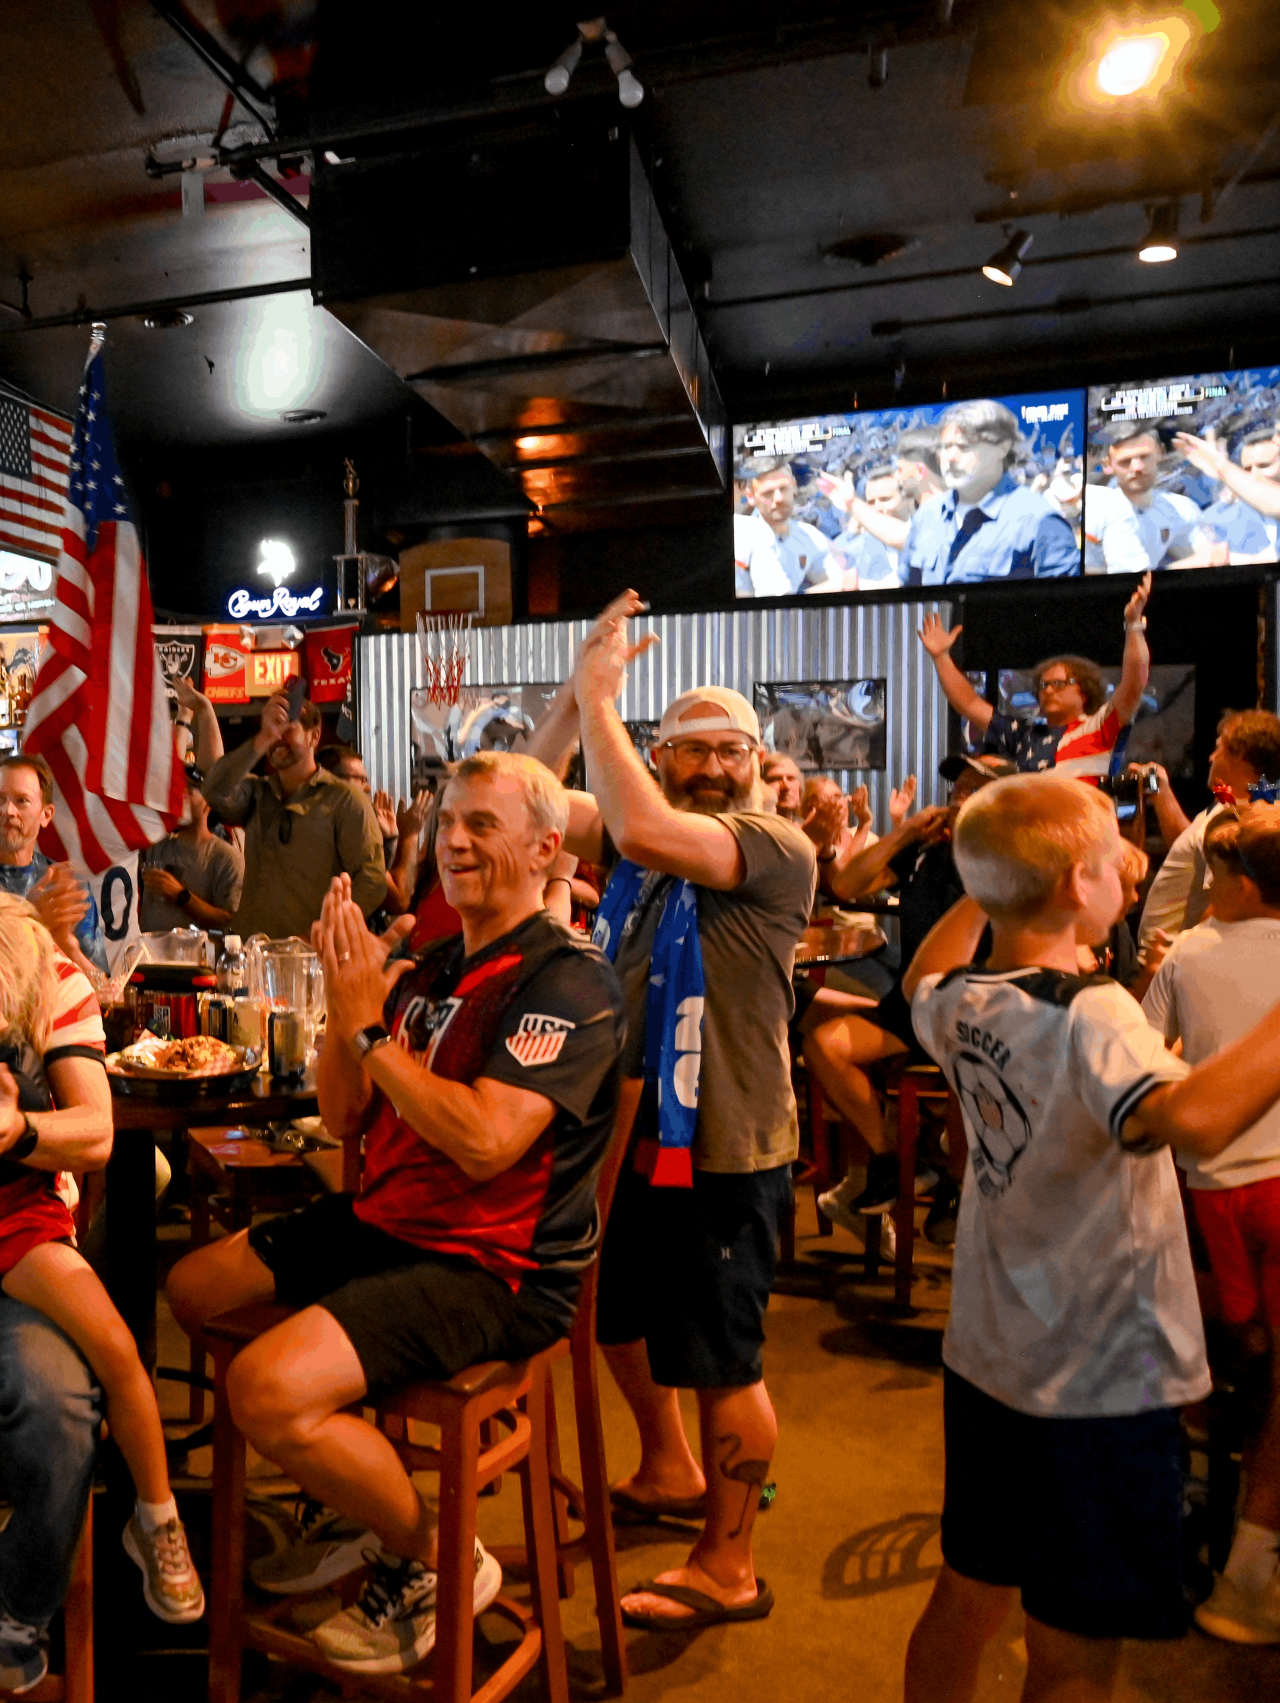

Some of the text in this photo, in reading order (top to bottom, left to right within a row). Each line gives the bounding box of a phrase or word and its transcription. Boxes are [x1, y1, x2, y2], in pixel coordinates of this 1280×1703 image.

[1205, 386, 1227, 397] FINAL
[228, 586, 324, 618] Crown Royal
[213, 652, 238, 669] KC
[254, 654, 293, 686] EXIT
[205, 687, 245, 698] CHIEFS
